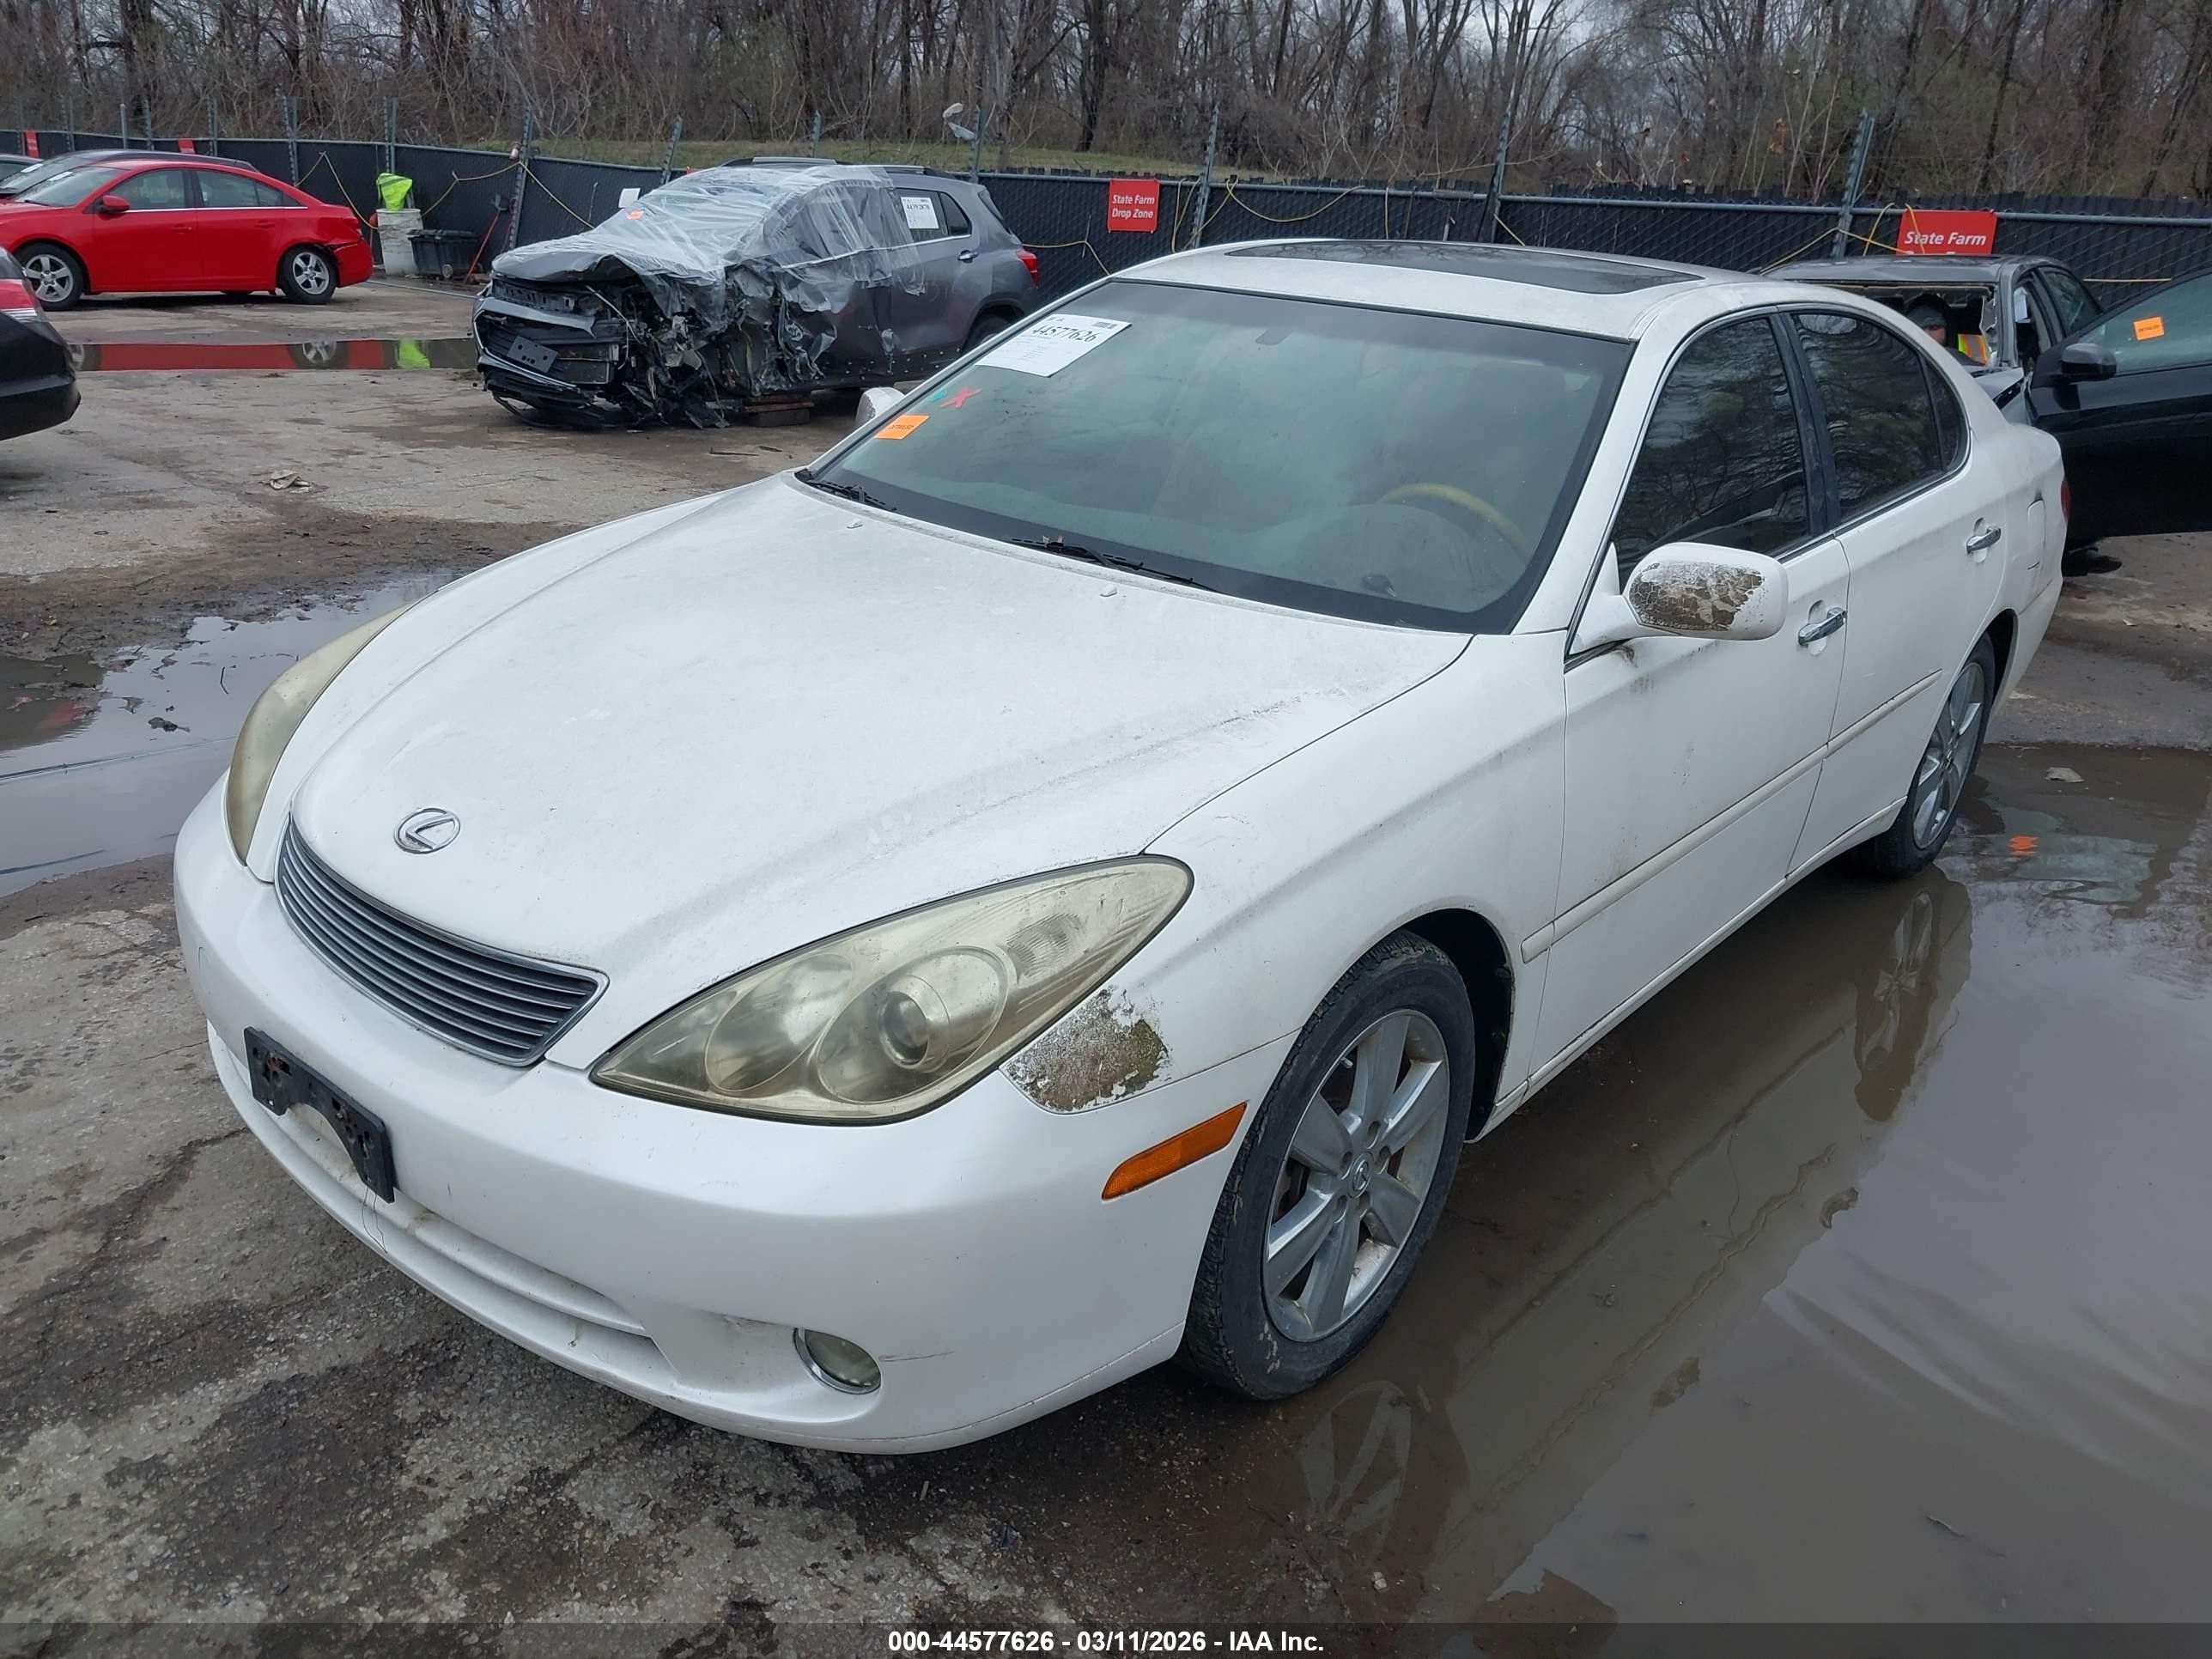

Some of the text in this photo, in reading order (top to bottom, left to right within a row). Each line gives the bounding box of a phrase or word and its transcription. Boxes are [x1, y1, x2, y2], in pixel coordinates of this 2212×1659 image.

[1112, 194, 1155, 204] State Farm
[1112, 208, 1154, 220] Drop Zone
[1905, 231, 1986, 246] State Farm
[1031, 325, 1102, 343] 44577626
